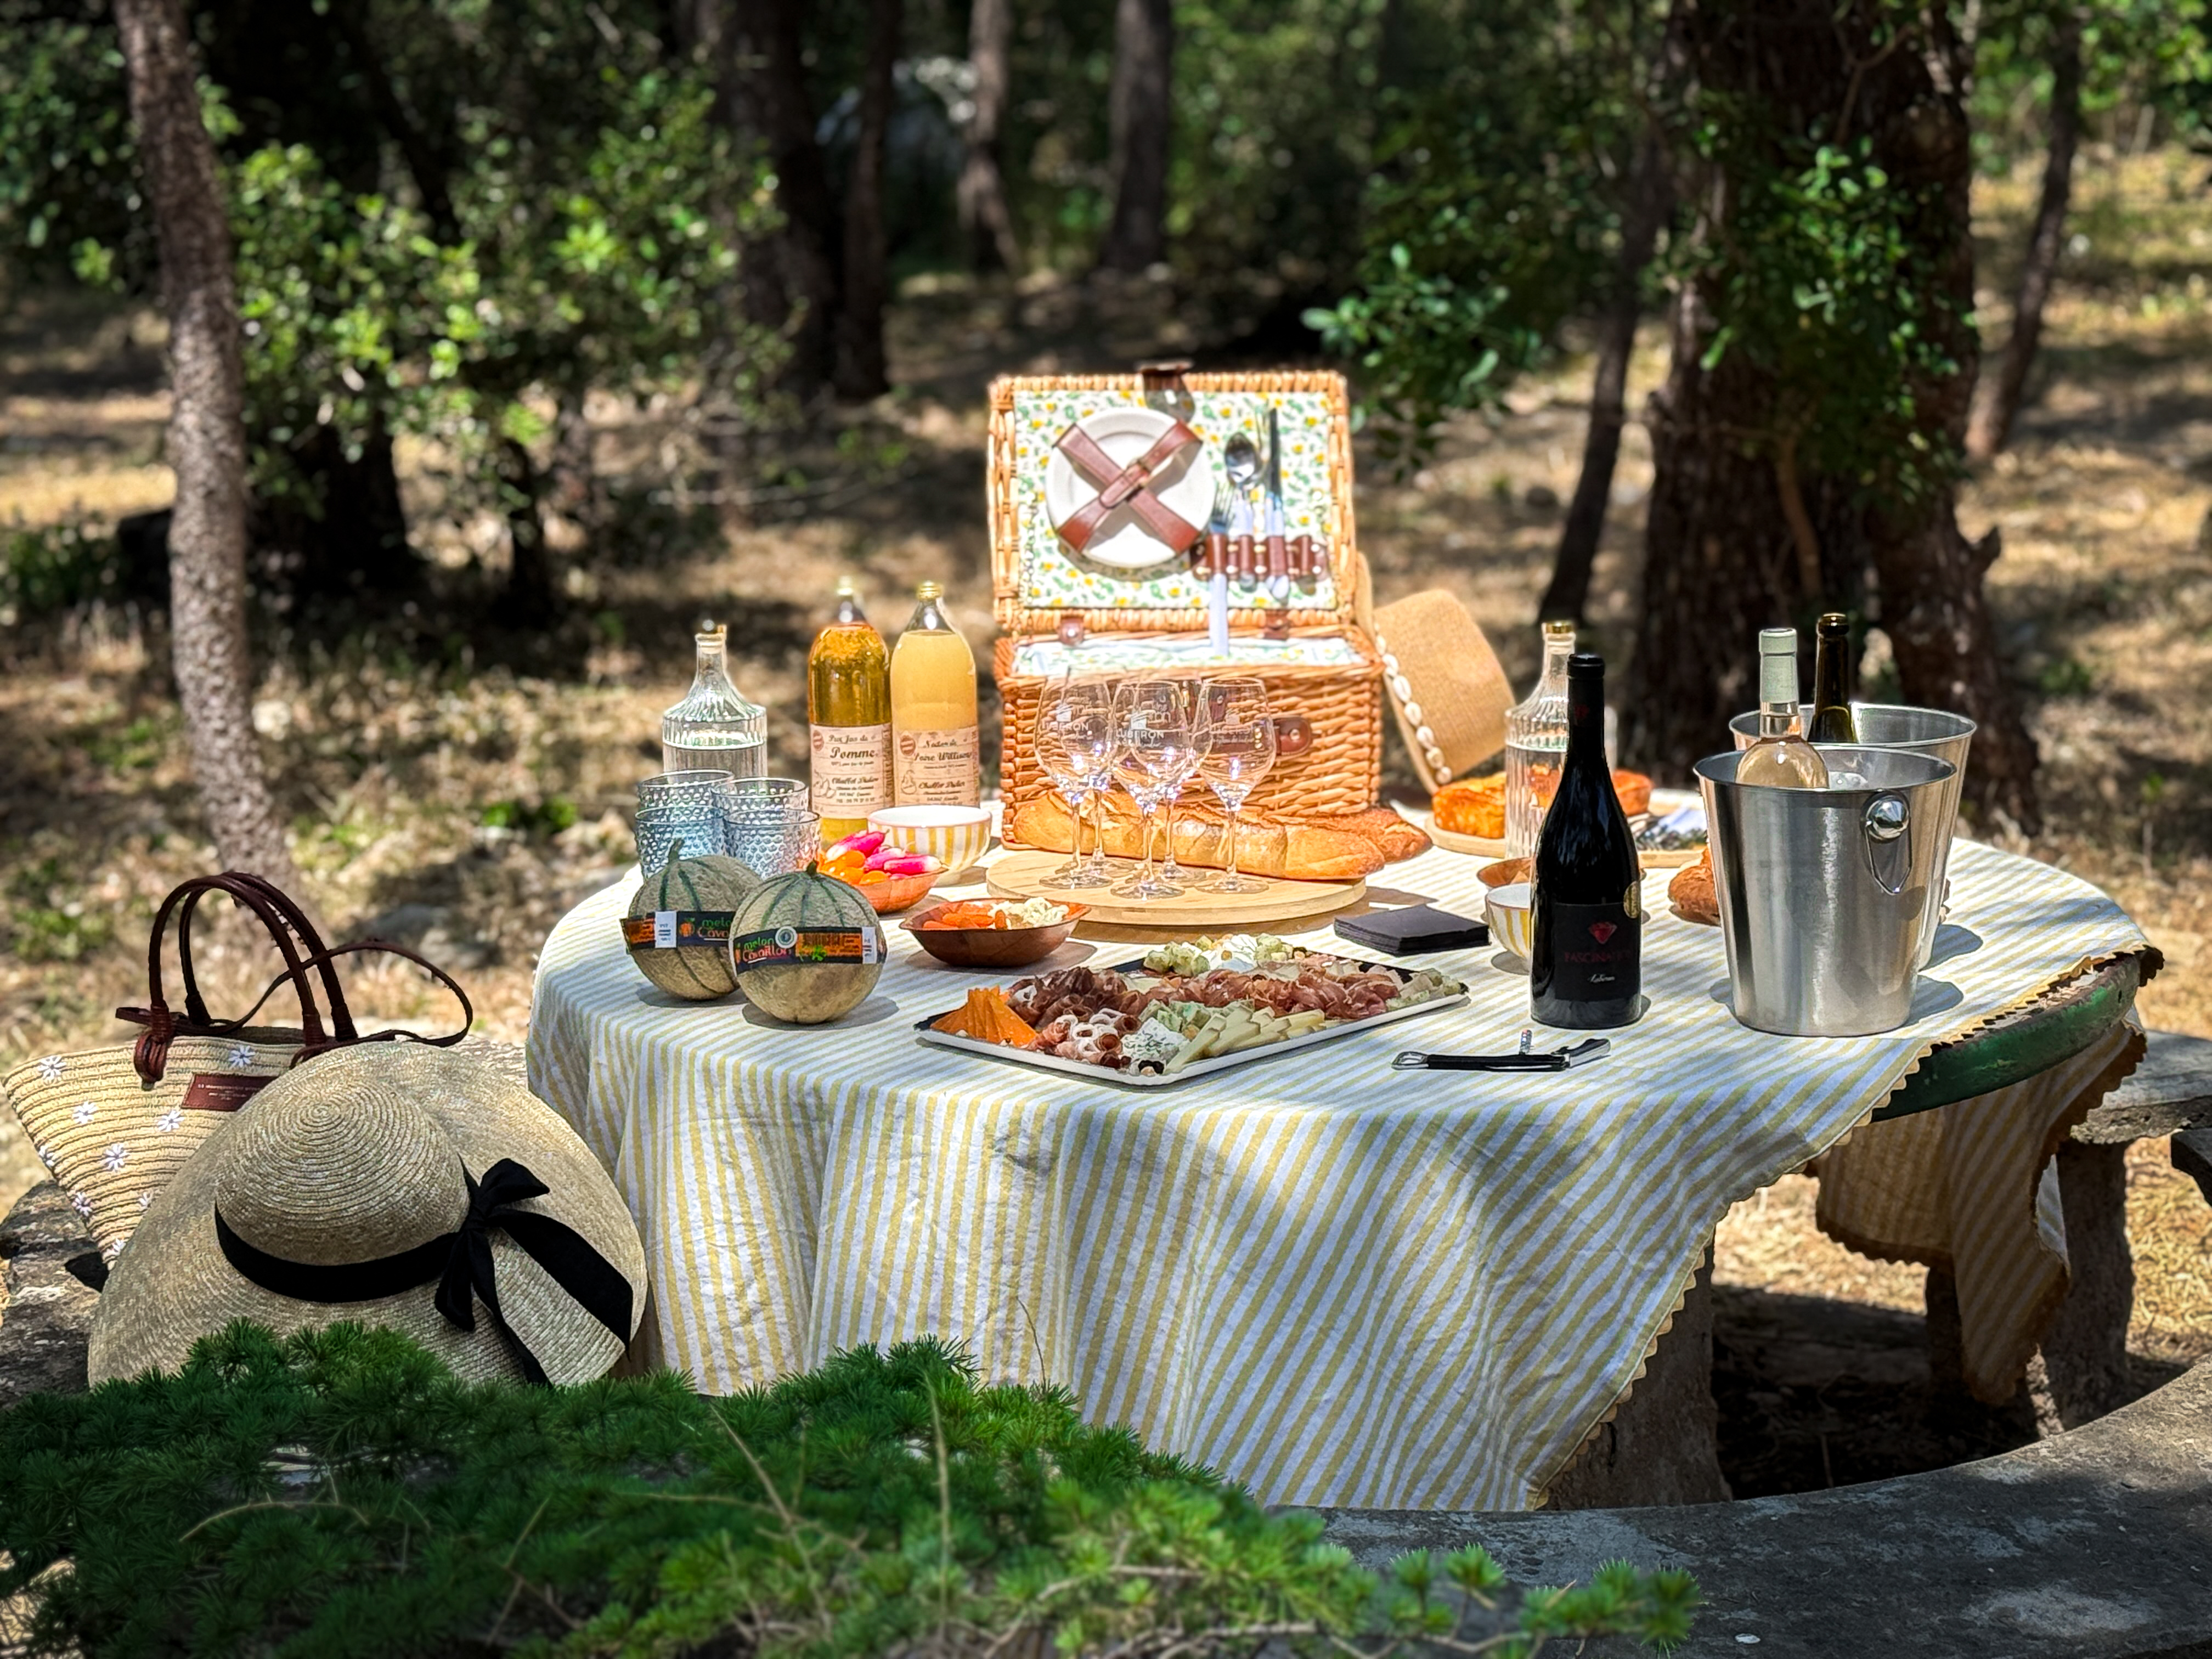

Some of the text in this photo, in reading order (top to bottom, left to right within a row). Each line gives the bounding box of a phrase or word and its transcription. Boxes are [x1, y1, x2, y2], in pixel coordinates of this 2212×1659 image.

[830, 746, 876, 759] Pomme
[702, 917, 731, 928] melo
[743, 936, 775, 950] melon
